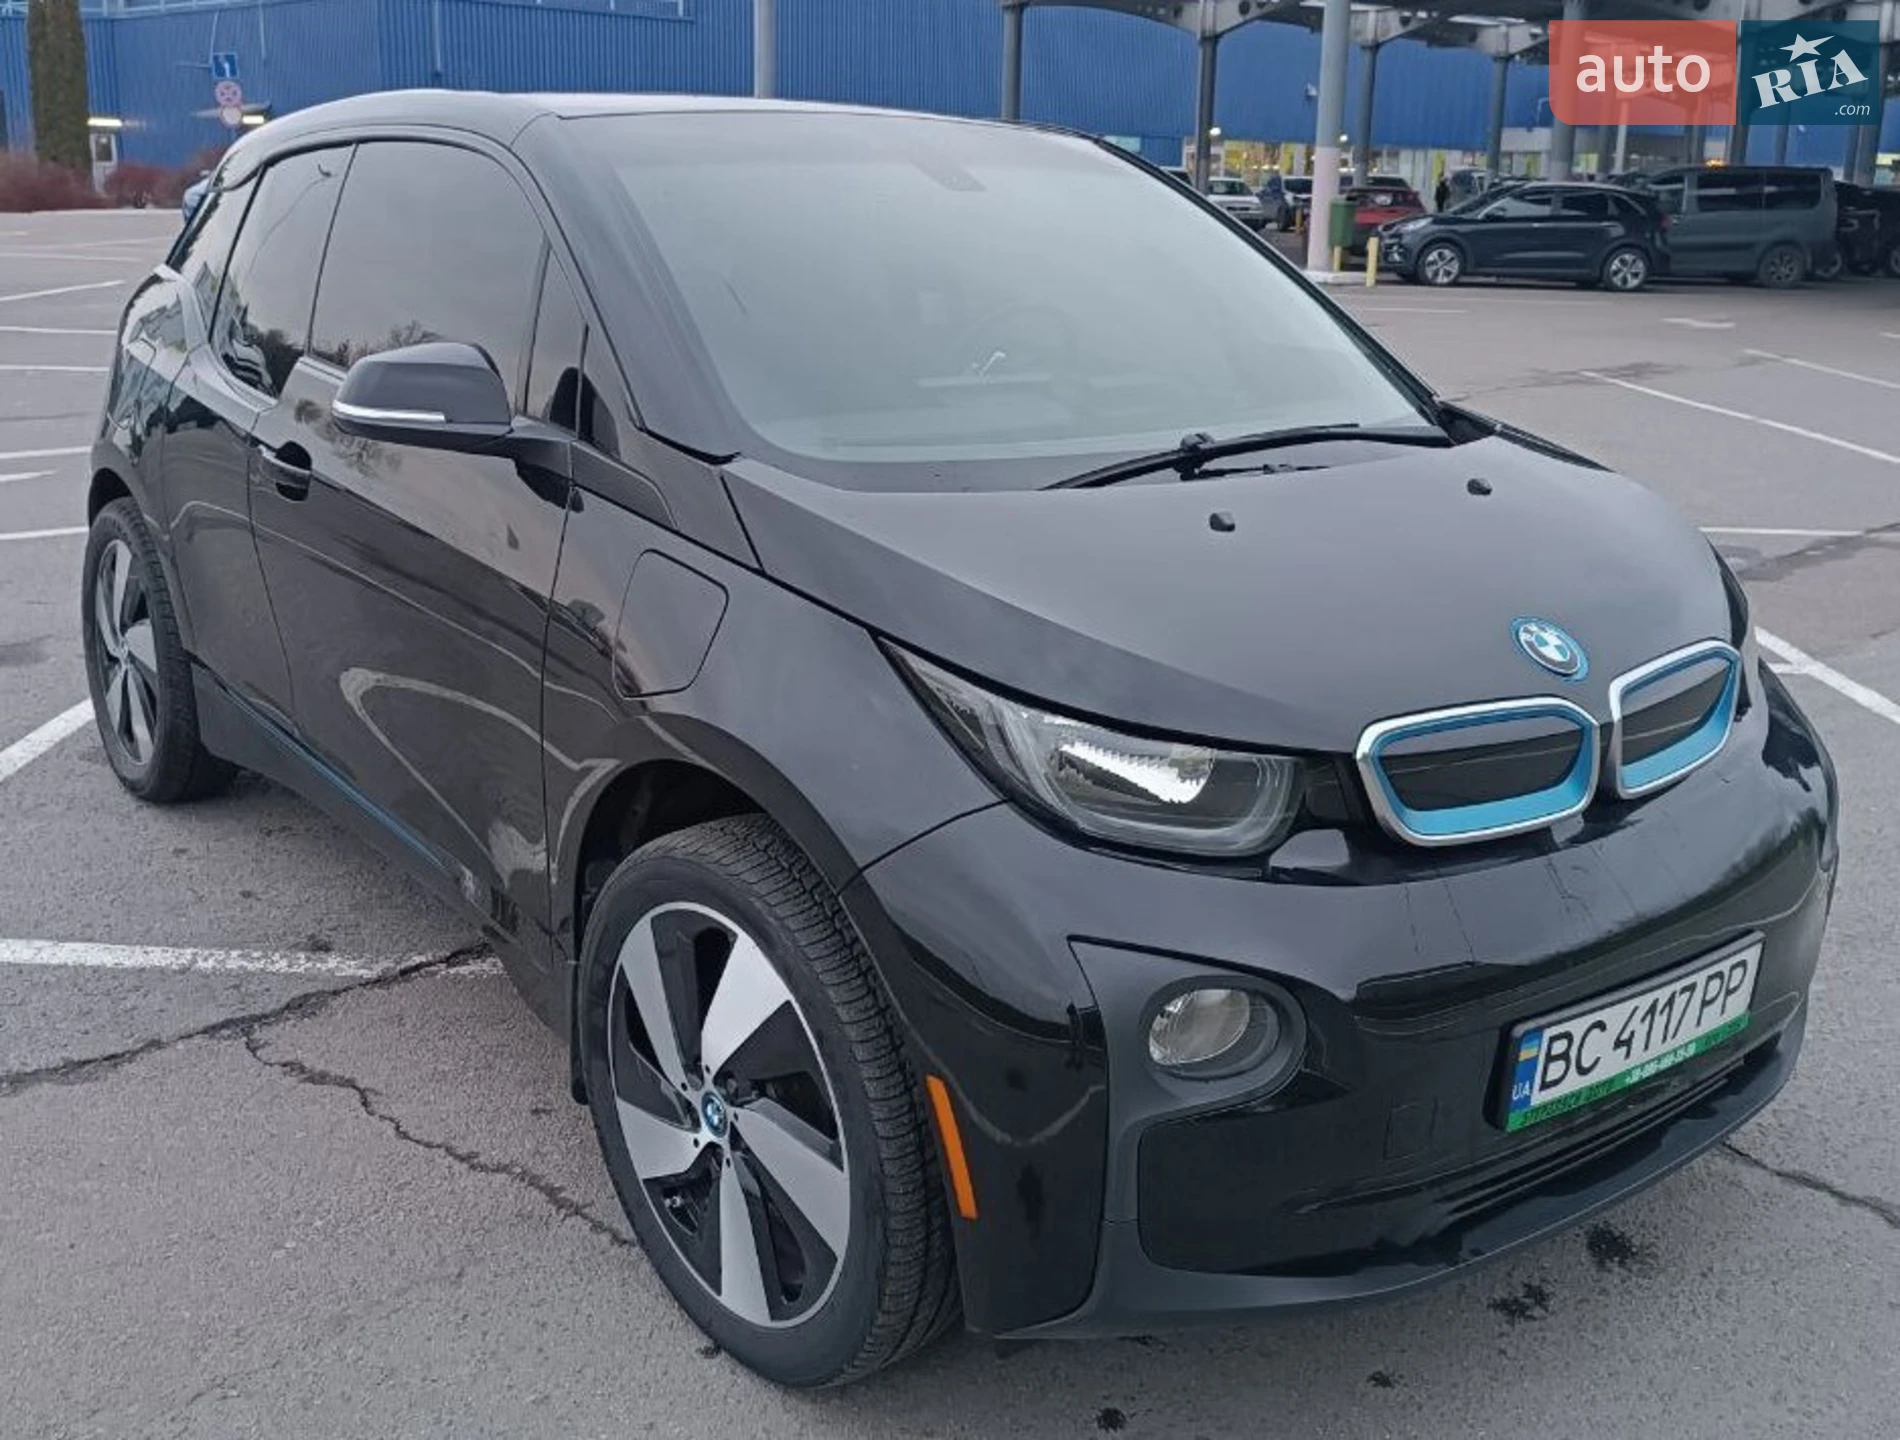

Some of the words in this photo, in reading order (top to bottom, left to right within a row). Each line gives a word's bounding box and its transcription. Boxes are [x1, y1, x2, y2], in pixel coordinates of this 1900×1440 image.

[1538, 1020, 1608, 1092] BC
[1613, 982, 1697, 1060] 4117
[1696, 958, 1748, 1027] PP
[1511, 1085, 1533, 1101] UA
